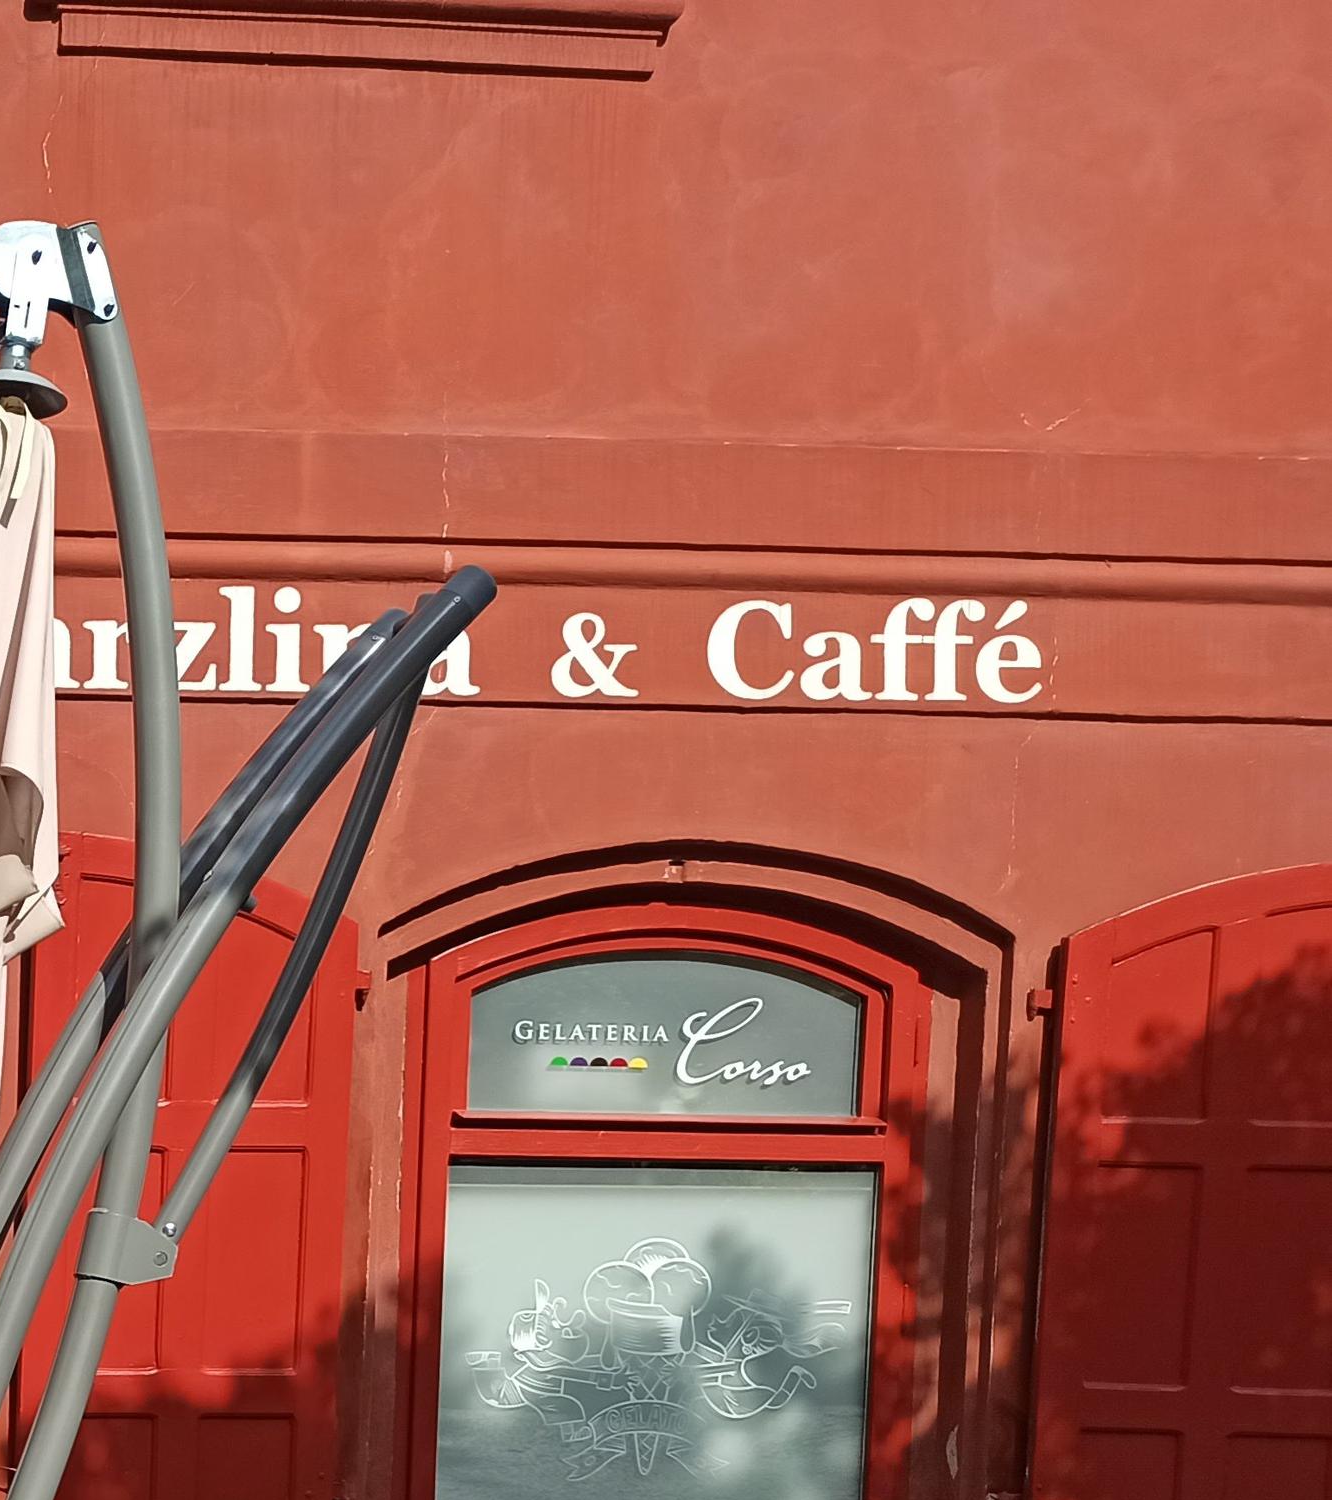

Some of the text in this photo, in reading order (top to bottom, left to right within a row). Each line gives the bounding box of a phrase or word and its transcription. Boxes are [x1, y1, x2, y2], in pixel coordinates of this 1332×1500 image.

[550, 612, 639, 698] &
[706, 598, 1043, 702] Caffé
[512, 997, 812, 1086] GELATERIA Corso
